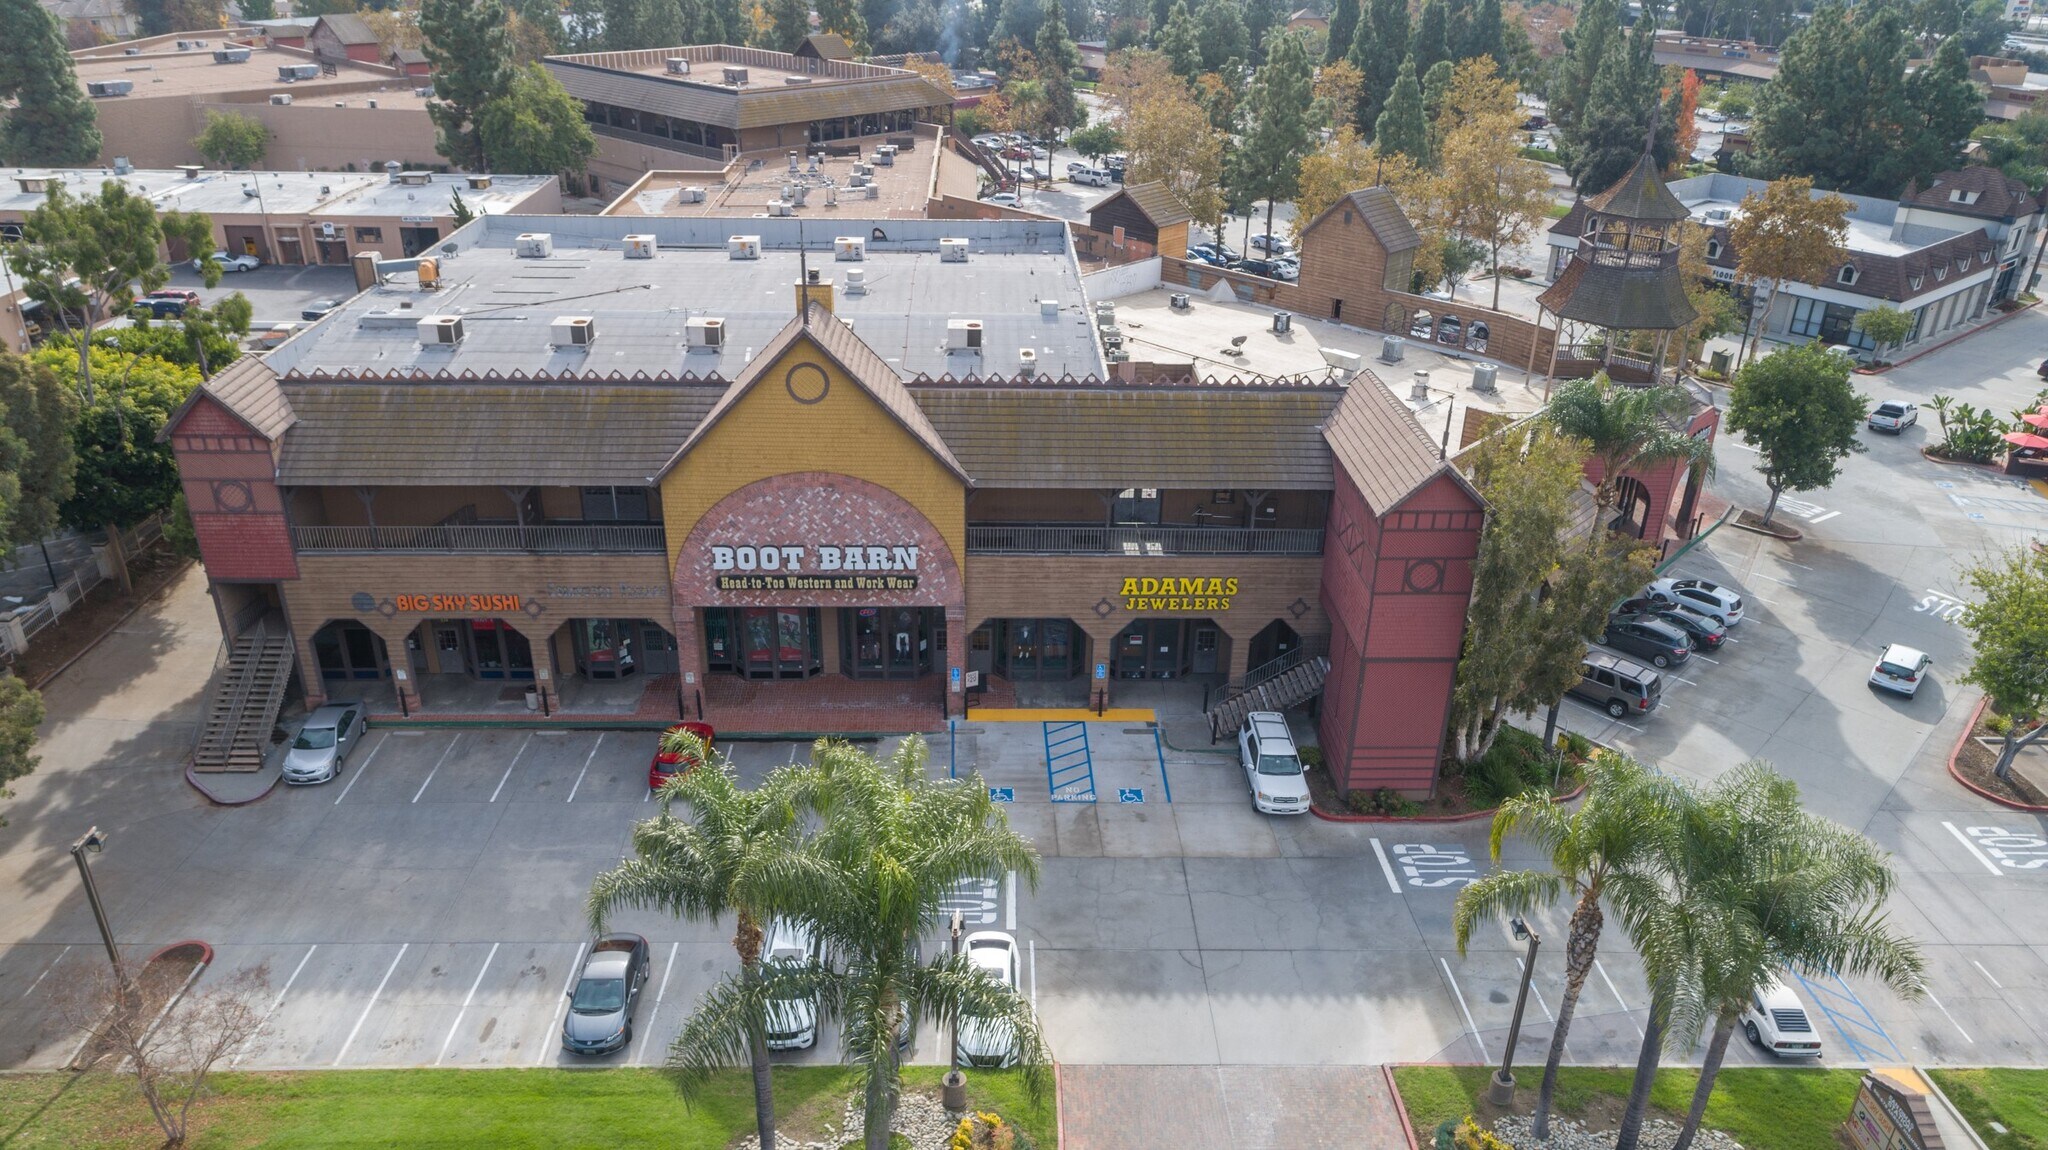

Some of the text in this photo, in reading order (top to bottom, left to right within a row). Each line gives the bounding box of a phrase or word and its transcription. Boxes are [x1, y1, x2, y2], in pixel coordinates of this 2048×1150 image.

[1713, 270, 1736, 280] FLOOR
[712, 546, 918, 570] BOOT BARN
[721, 577, 915, 589] Head-to-Toe Western and Work Wear
[1120, 578, 1238, 596] ADAMAS
[397, 595, 520, 612] BIG SKY SUSHI
[1125, 597, 1230, 610] JEWELERS
[1913, 595, 1966, 624] STO
[1966, 827, 2048, 869] STOP
[1393, 844, 1479, 887] STOP
